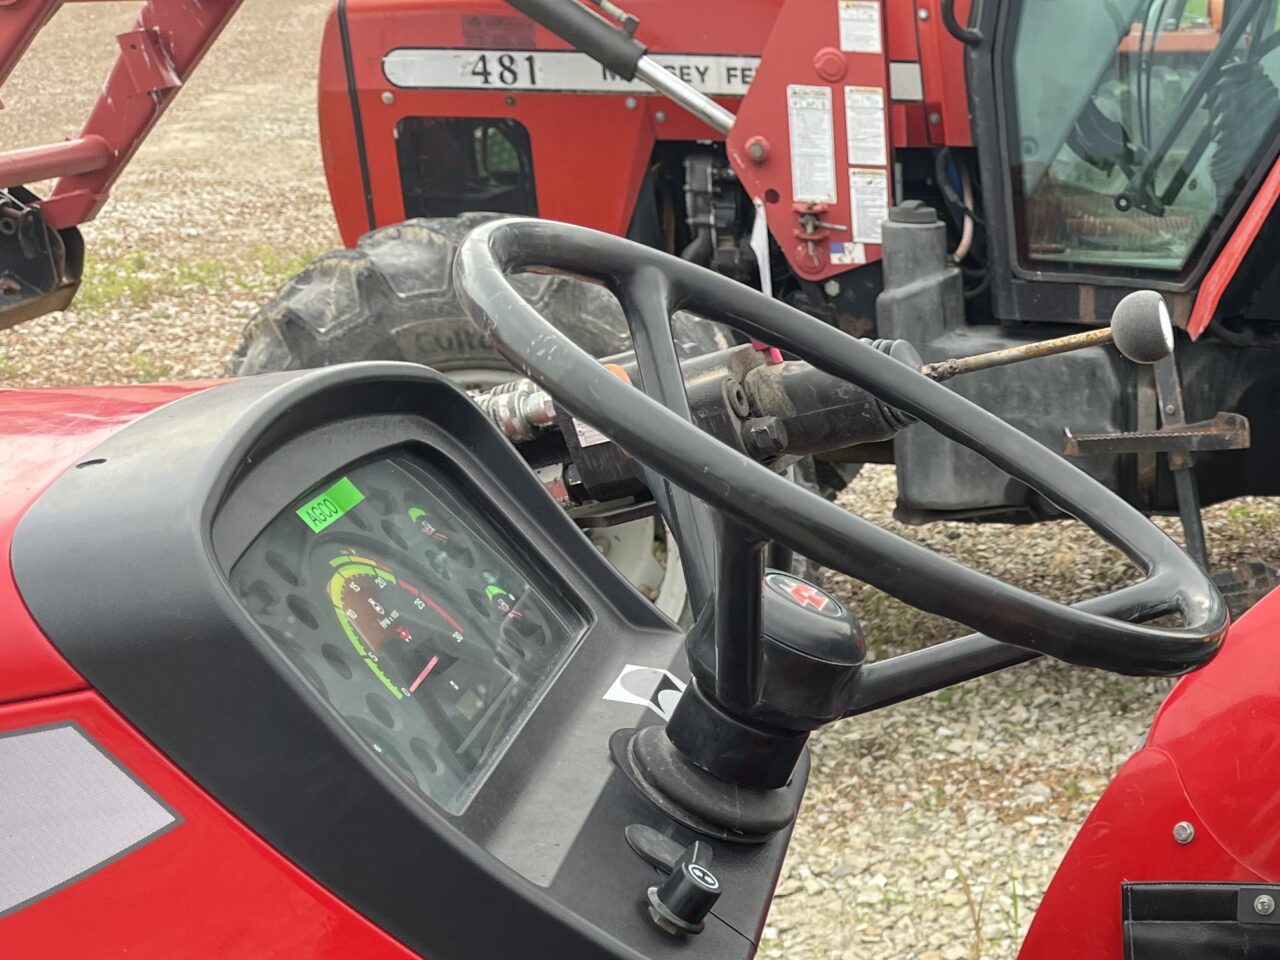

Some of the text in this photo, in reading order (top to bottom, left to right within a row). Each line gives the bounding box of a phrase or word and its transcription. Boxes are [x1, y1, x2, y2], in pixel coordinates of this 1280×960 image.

[472, 54, 537, 85] 481
[305, 498, 339, 528] AGCO
[349, 581, 361, 593] 15
[374, 576, 387, 589] 20
[367, 651, 379, 662] 5
[401, 687, 411, 697] 0
